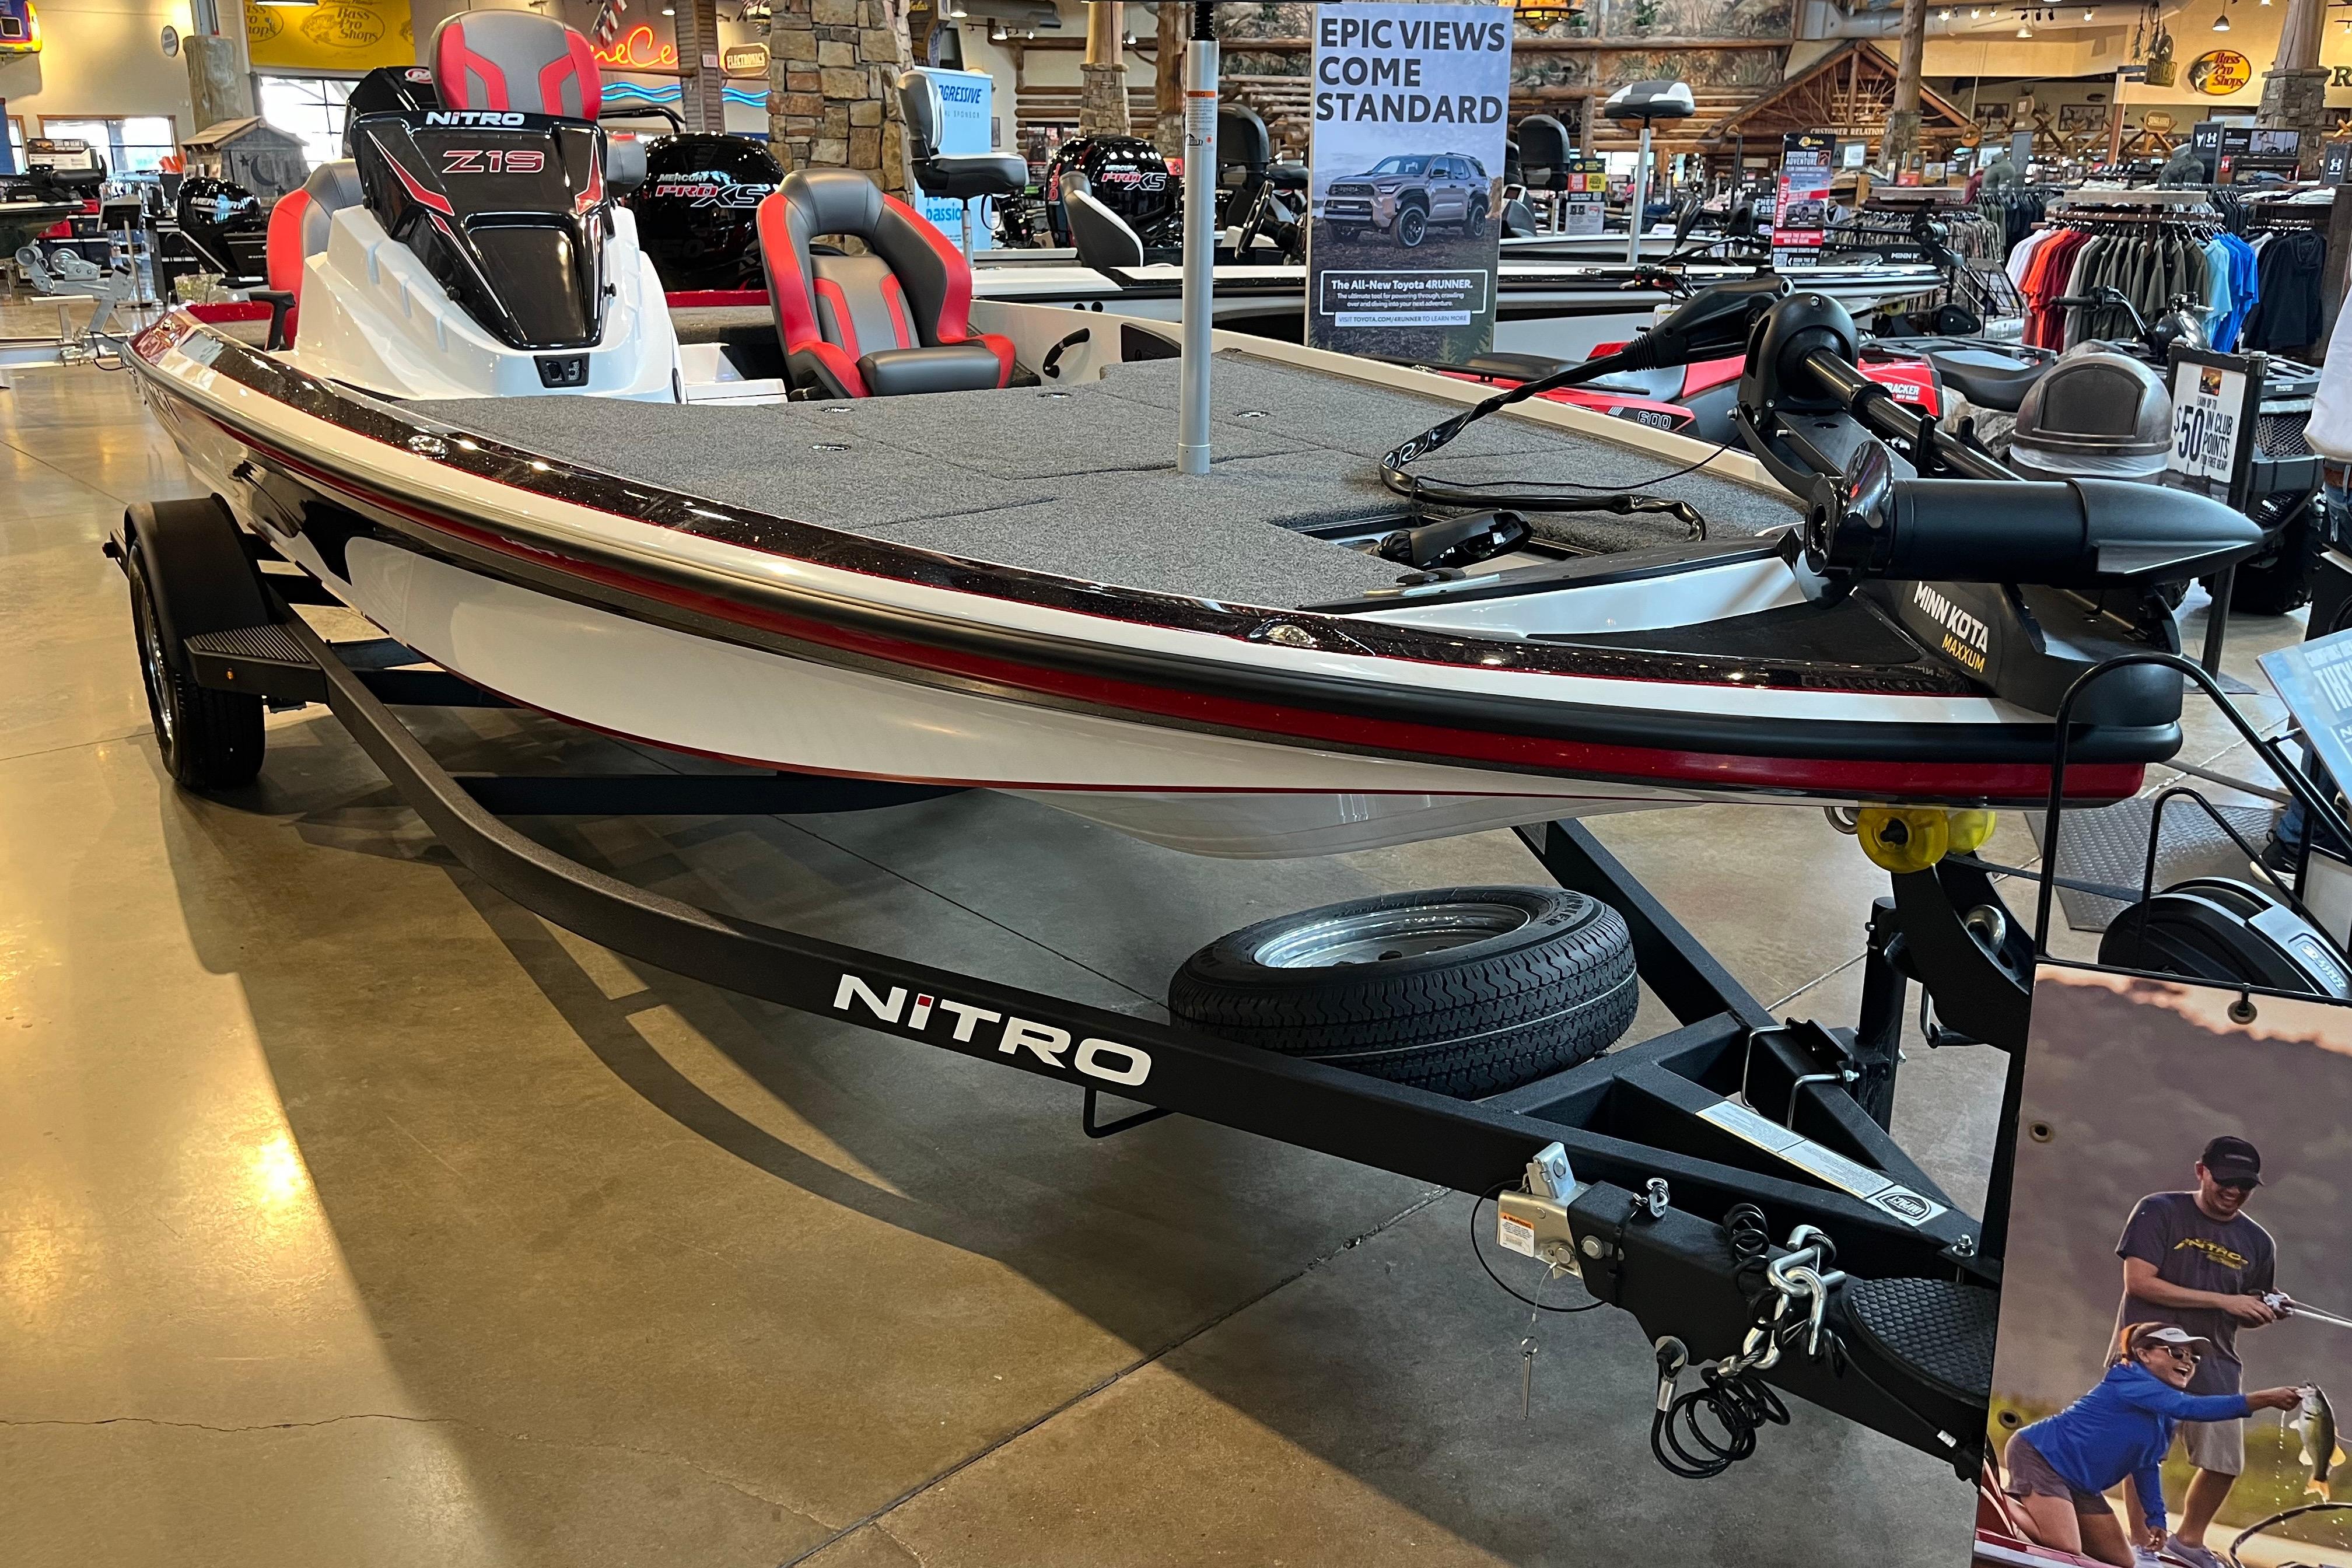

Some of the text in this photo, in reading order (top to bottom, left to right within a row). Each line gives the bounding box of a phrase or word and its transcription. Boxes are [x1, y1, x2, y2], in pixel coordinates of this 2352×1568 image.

[337, 7, 370, 20] Bass
[338, 19, 363, 29] Pro
[338, 29, 379, 44] Shops
[1321, 18, 1505, 51] EPIC VIEWS
[727, 52, 765, 69] ELECTRONICS
[2214, 52, 2241, 64] Bass
[1319, 56, 1421, 86] COME
[2213, 64, 2234, 75] Pro
[2212, 75, 2245, 89] Shops
[1316, 92, 1503, 123] STANDARD
[1850, 127, 1885, 135] RELATION
[442, 150, 545, 173] Z19
[657, 170, 710, 182] MERCURY
[926, 208, 963, 222] passio
[1331, 279, 1473, 292] The All-New Toyota 4RUNNER.
[1637, 411, 1672, 429] 600
[2174, 404, 2233, 462] $50 IN CLUB
[2202, 432, 2230, 459] POINTS
[1913, 581, 1989, 653] MINN KOTA
[1941, 634, 1985, 673] MAXXUM
[1887, 1195, 1926, 1214] IMPACT
[1508, 1216, 1531, 1228] WARNING
